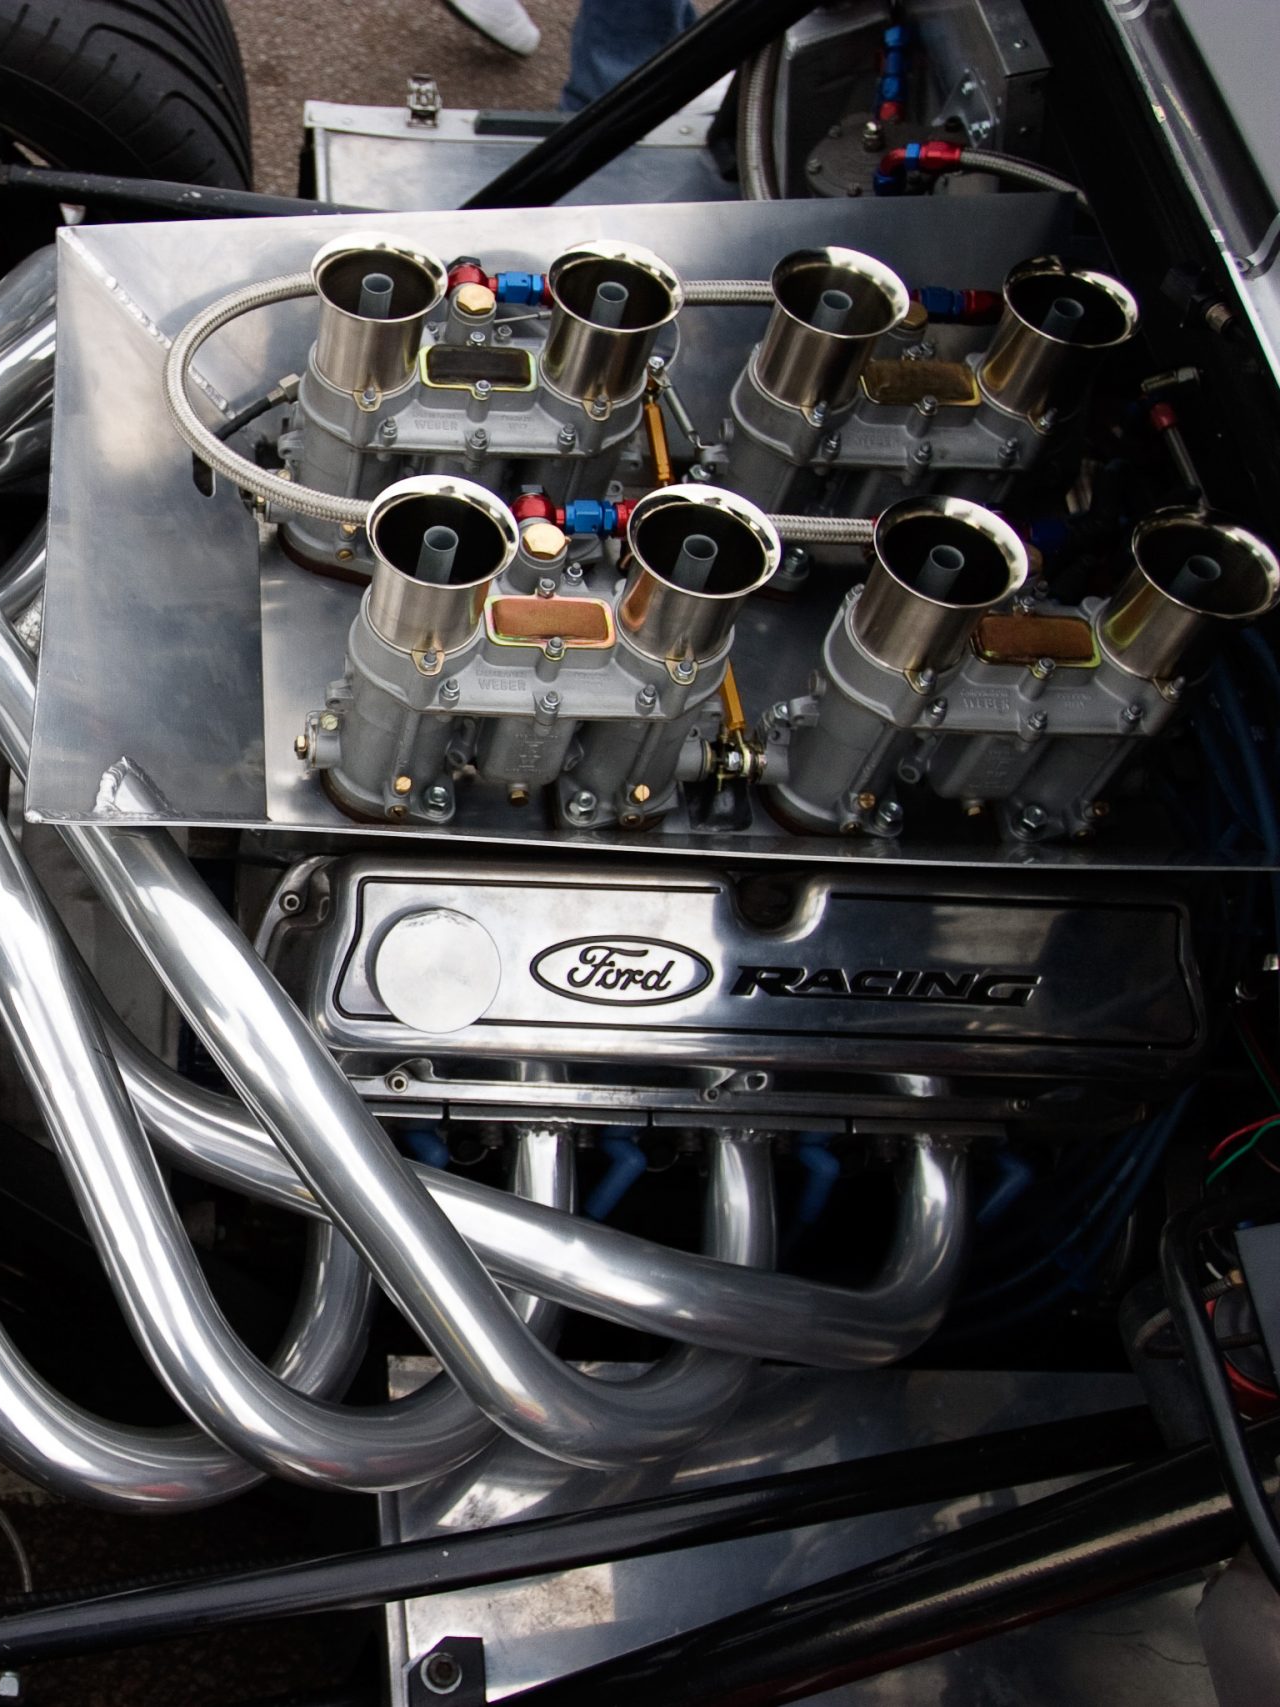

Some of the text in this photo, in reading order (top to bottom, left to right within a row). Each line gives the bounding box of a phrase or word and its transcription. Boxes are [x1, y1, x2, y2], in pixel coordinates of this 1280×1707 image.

[478, 679, 526, 691] WEBER
[566, 944, 1043, 1007] Ford RACING
